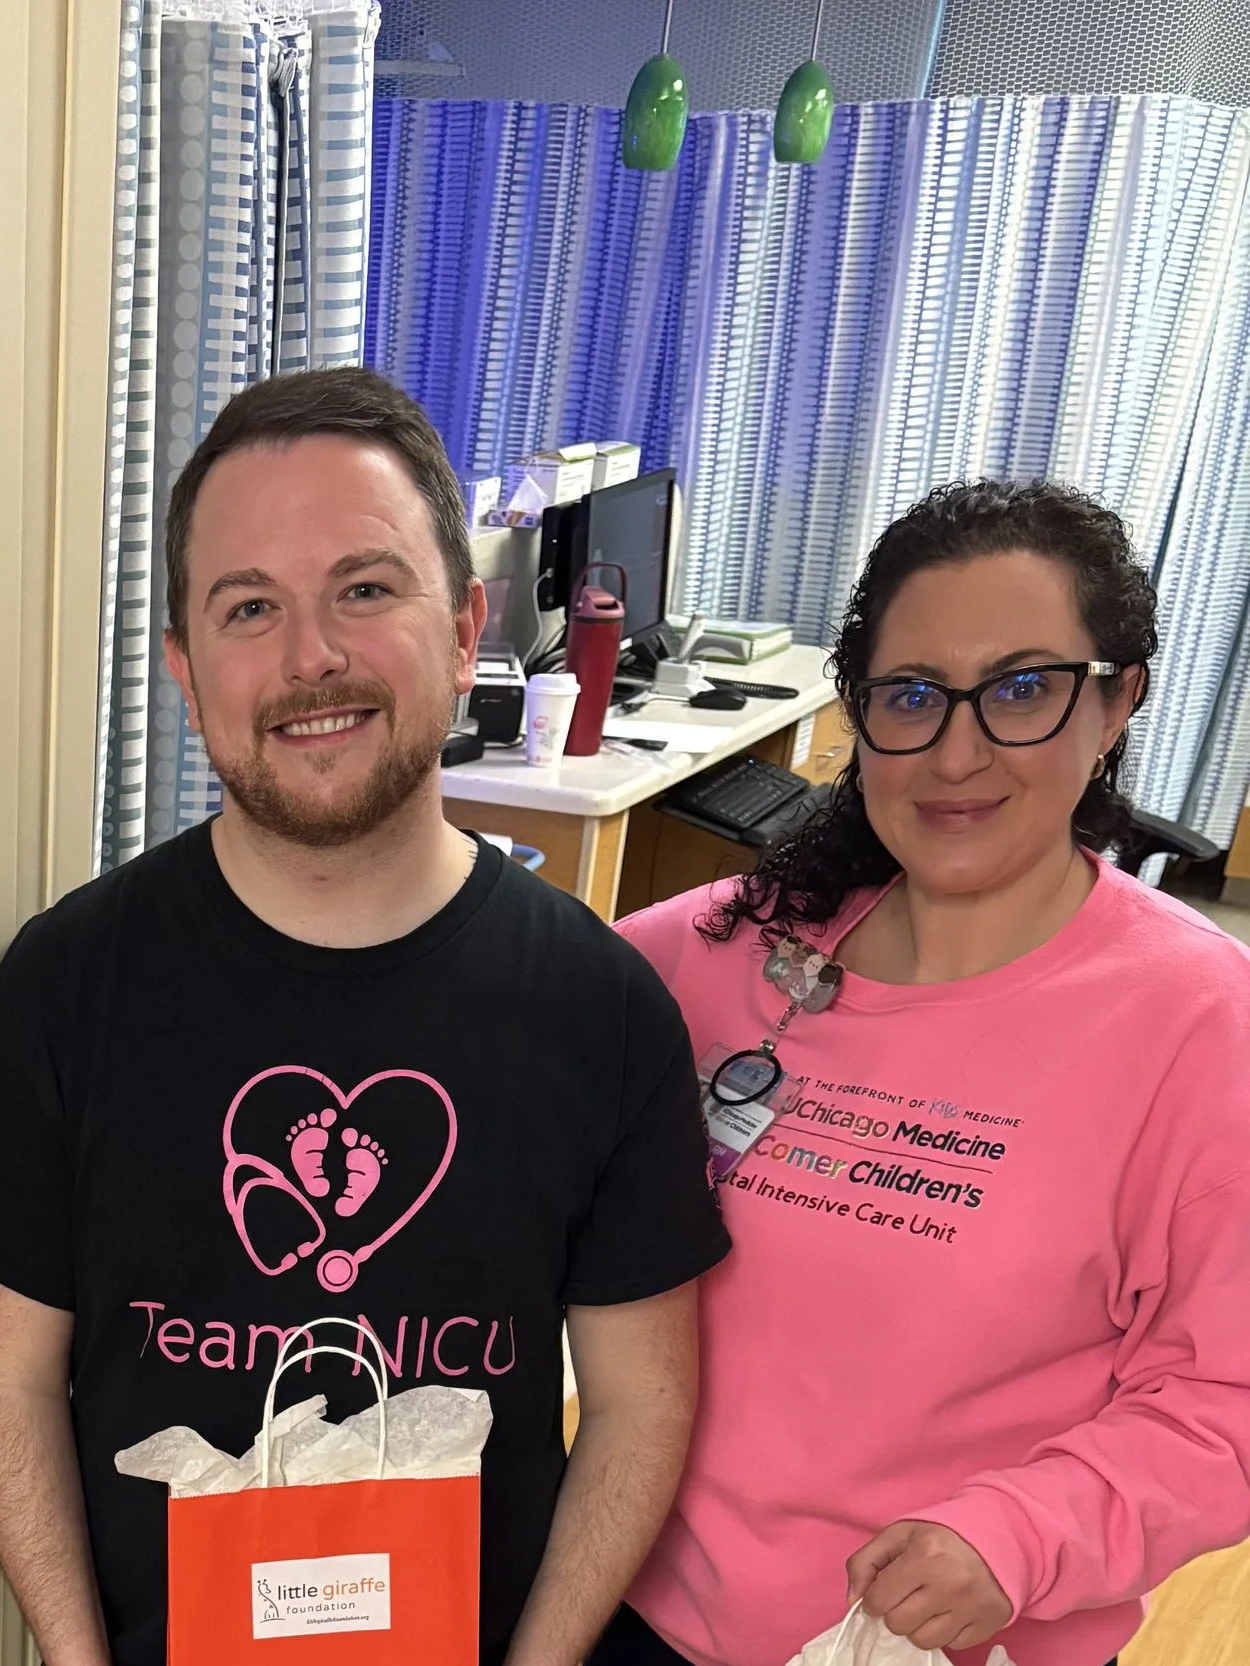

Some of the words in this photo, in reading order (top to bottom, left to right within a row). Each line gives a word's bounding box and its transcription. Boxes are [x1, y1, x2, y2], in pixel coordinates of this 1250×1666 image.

[797, 1075, 811, 1086] AT
[816, 1079, 835, 1092] THE
[837, 1085, 905, 1105] FOREFRONT
[909, 1099, 926, 1109] OF
[892, 1121, 1006, 1161] Medicine
[754, 1135, 848, 1180] Comer
[848, 1161, 984, 1209] Children's
[759, 1177, 851, 1217] Intensive
[855, 1203, 905, 1230] Care
[909, 1214, 957, 1244] Unit
[129, 1301, 315, 1374] Team
[351, 1313, 516, 1378] NICU
[278, 1583, 318, 1600] little
[323, 1577, 386, 1600] giraffe
[286, 1602, 356, 1615] foundation
